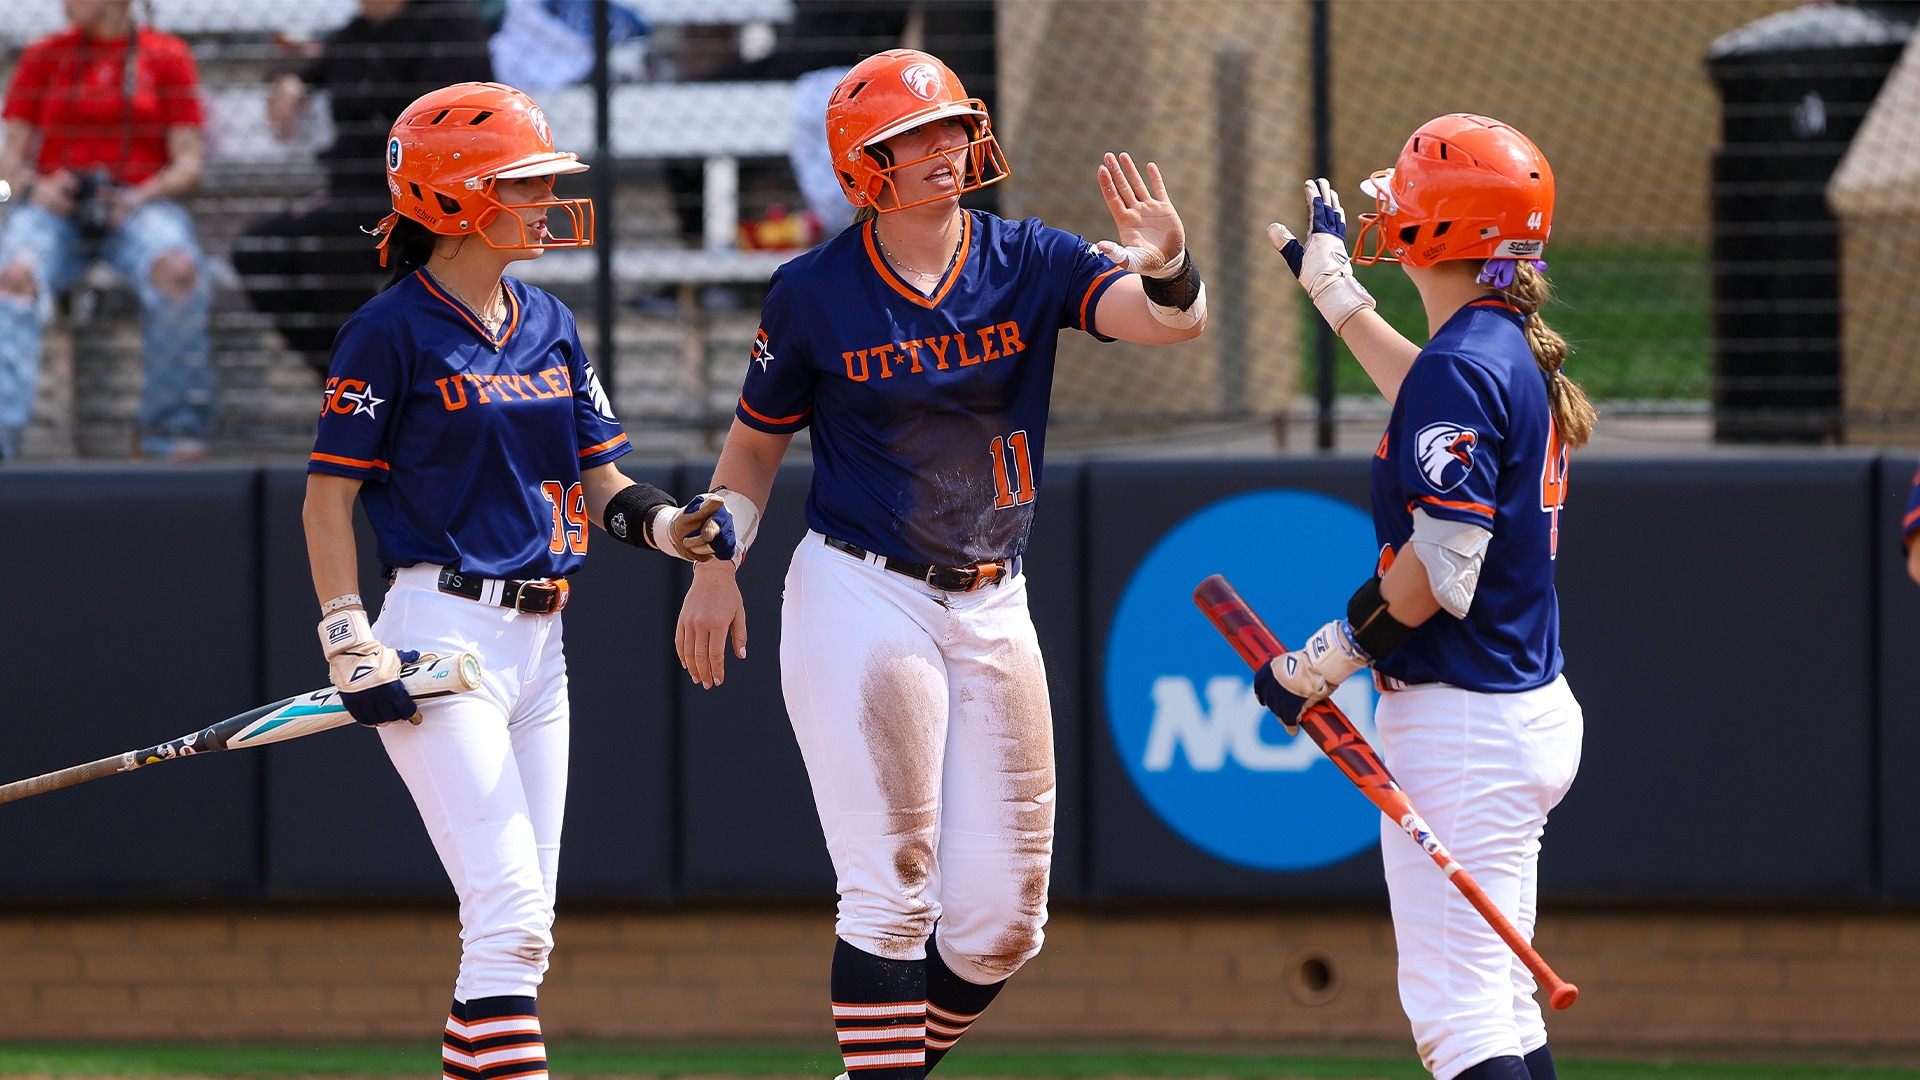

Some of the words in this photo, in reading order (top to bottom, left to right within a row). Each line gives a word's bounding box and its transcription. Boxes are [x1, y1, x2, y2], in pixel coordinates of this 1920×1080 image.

[1527, 211, 1543, 231] 44
[989, 430, 1036, 510] 11
[541, 480, 589, 556] 39
[438, 572, 463, 588] TS
